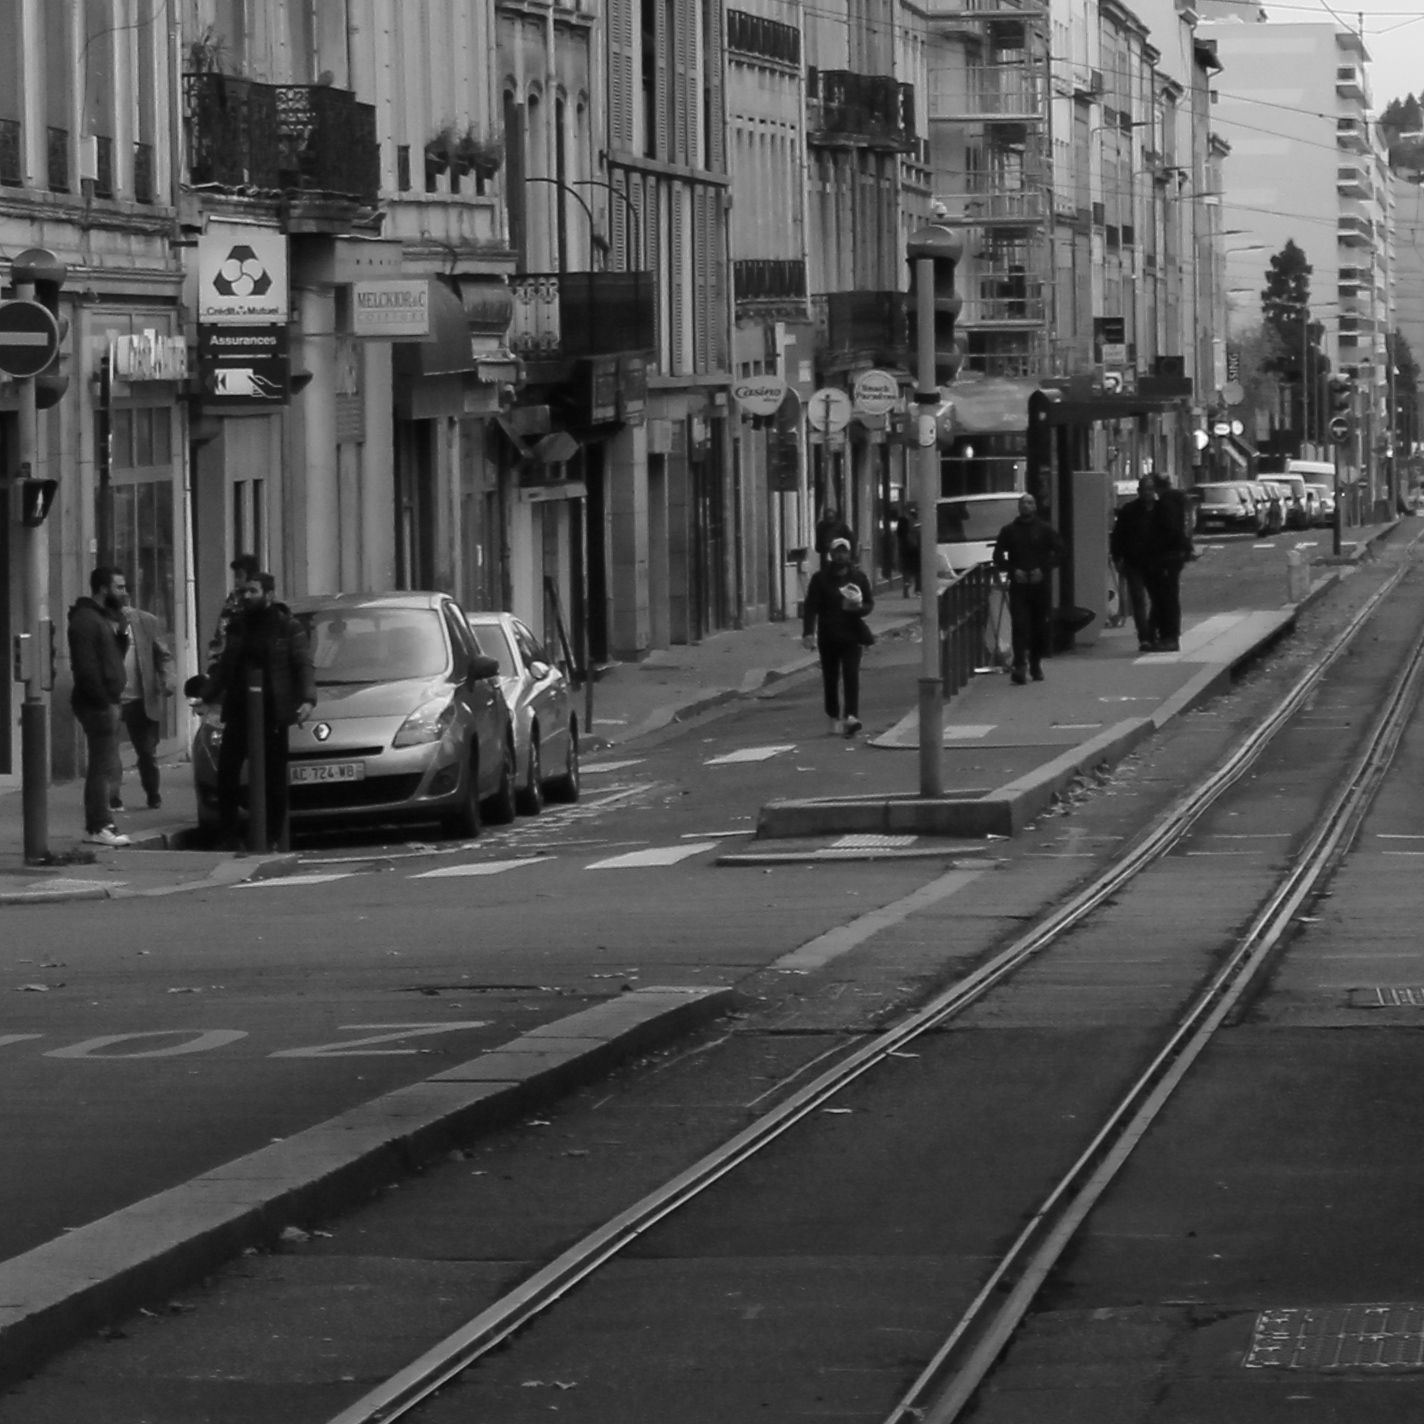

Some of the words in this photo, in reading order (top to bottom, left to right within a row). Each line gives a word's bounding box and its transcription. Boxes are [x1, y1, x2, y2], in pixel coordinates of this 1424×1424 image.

[207, 306, 235, 316] Crédit
[247, 306, 279, 315] Mutuel
[209, 335, 277, 346] Assurances
[735, 386, 781, 399] Casino
